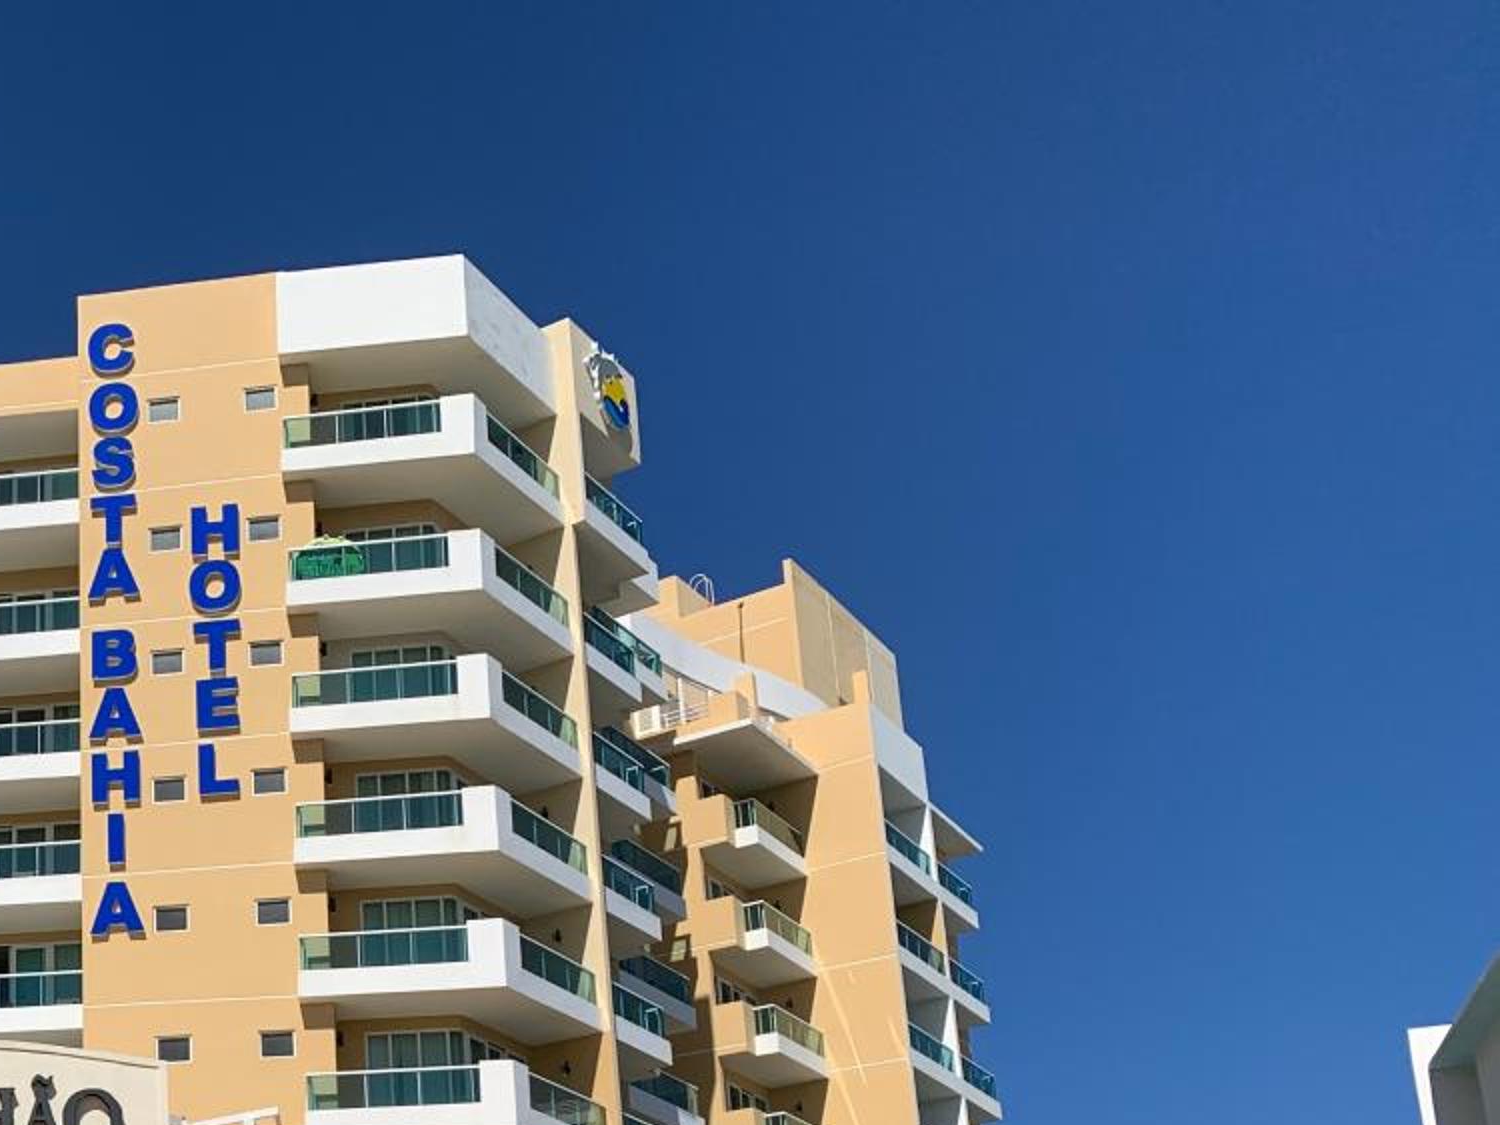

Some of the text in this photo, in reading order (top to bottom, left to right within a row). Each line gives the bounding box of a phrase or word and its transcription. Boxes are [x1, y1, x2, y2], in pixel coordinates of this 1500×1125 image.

[88, 323, 146, 941] COSTA BAHIA
[189, 503, 241, 800] HOTEL
